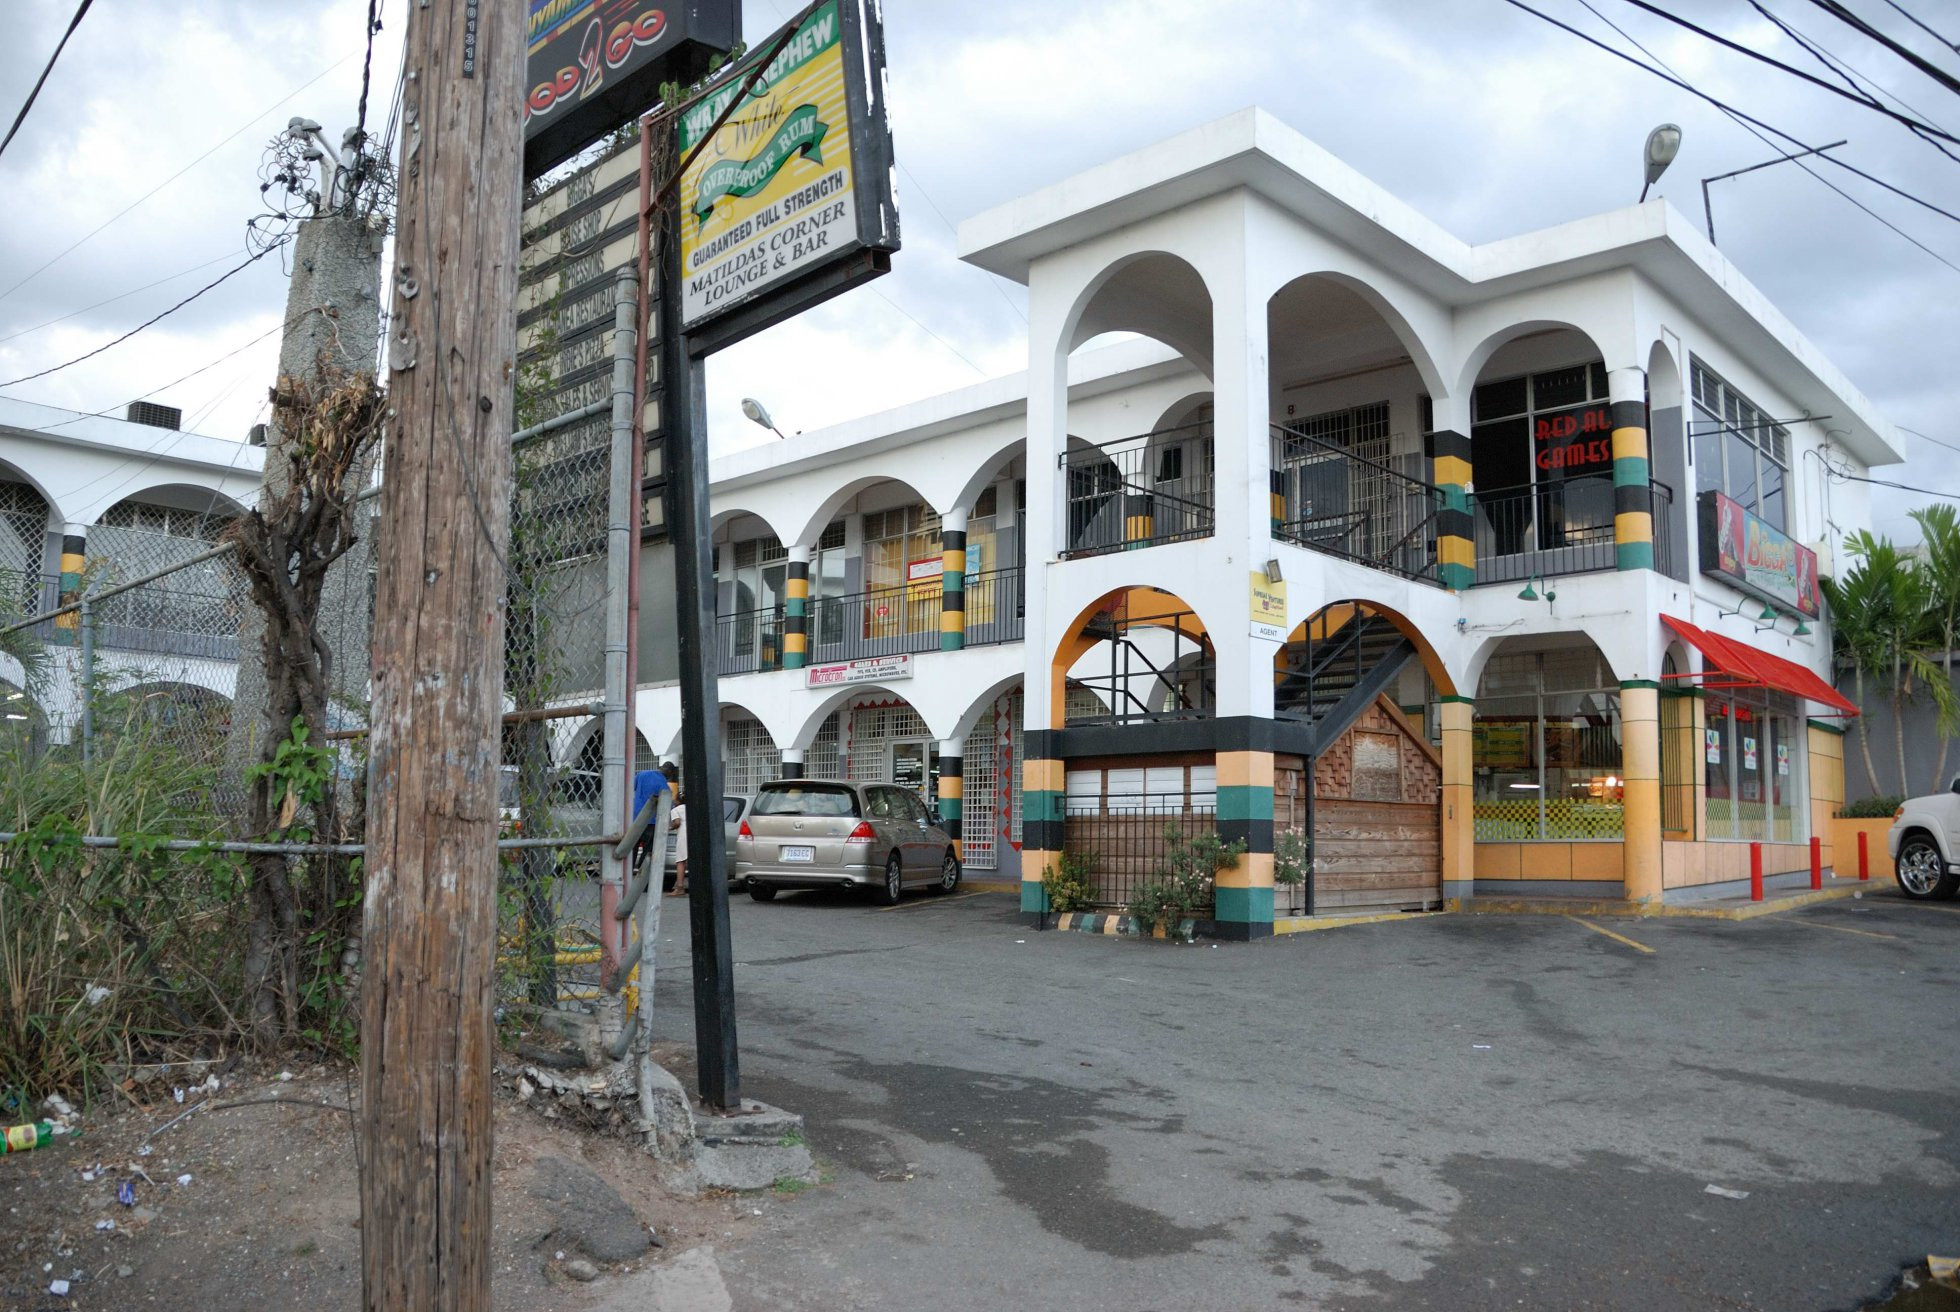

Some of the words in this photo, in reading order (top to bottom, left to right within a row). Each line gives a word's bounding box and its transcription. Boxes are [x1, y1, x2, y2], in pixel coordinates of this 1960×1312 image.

[524, 66, 581, 128] OD
[578, 17, 603, 100] 2
[605, 9, 668, 69] GO
[703, 152, 775, 197] OVERPROOF
[778, 115, 815, 150] RUM
[689, 242, 766, 297] MATILDAS
[770, 201, 846, 251] CORNER
[693, 222, 752, 268] GUARANTEED
[756, 205, 780, 232] FULL
[784, 171, 843, 216] STRENGTH
[576, 286, 616, 326] RESTAURAN
[704, 259, 768, 306] LOUNGE
[773, 252, 786, 270] &
[792, 230, 828, 261] BAR
[1535, 415, 1577, 440] RED
[1537, 440, 1609, 470] GAMES
[1260, 627, 1277, 637] AGENT
